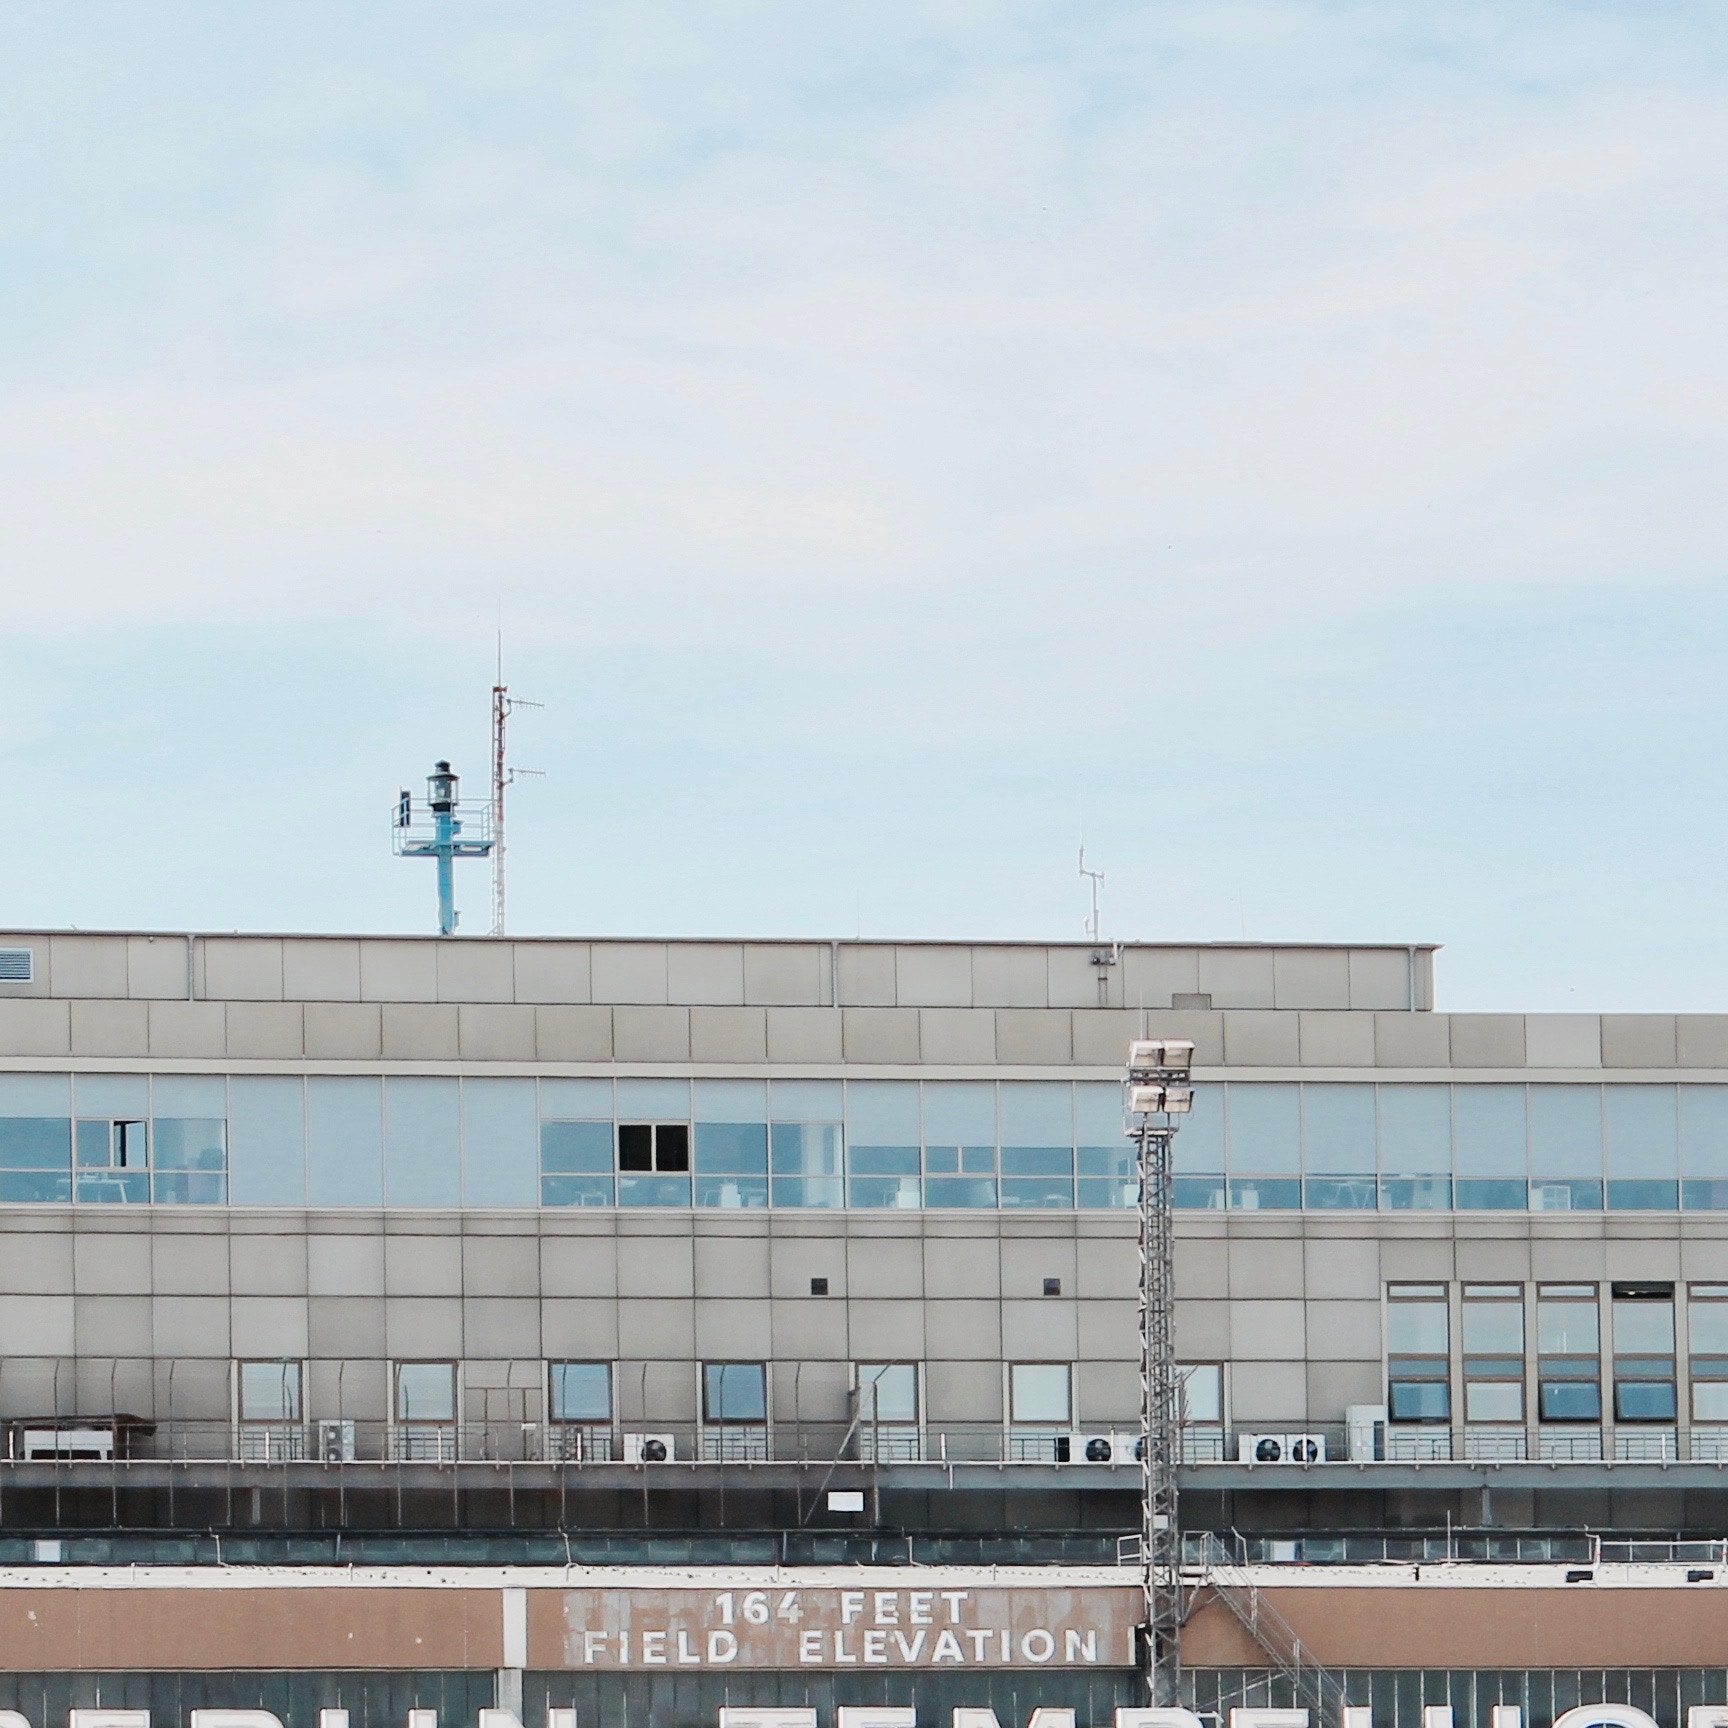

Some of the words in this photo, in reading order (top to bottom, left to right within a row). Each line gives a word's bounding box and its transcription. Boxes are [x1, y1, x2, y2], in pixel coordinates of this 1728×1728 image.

[714, 1591, 804, 1625] 164
[840, 1591, 970, 1625] FEET
[582, 1629, 739, 1665] FIELD
[799, 1628, 1098, 1664] ELEVATION
